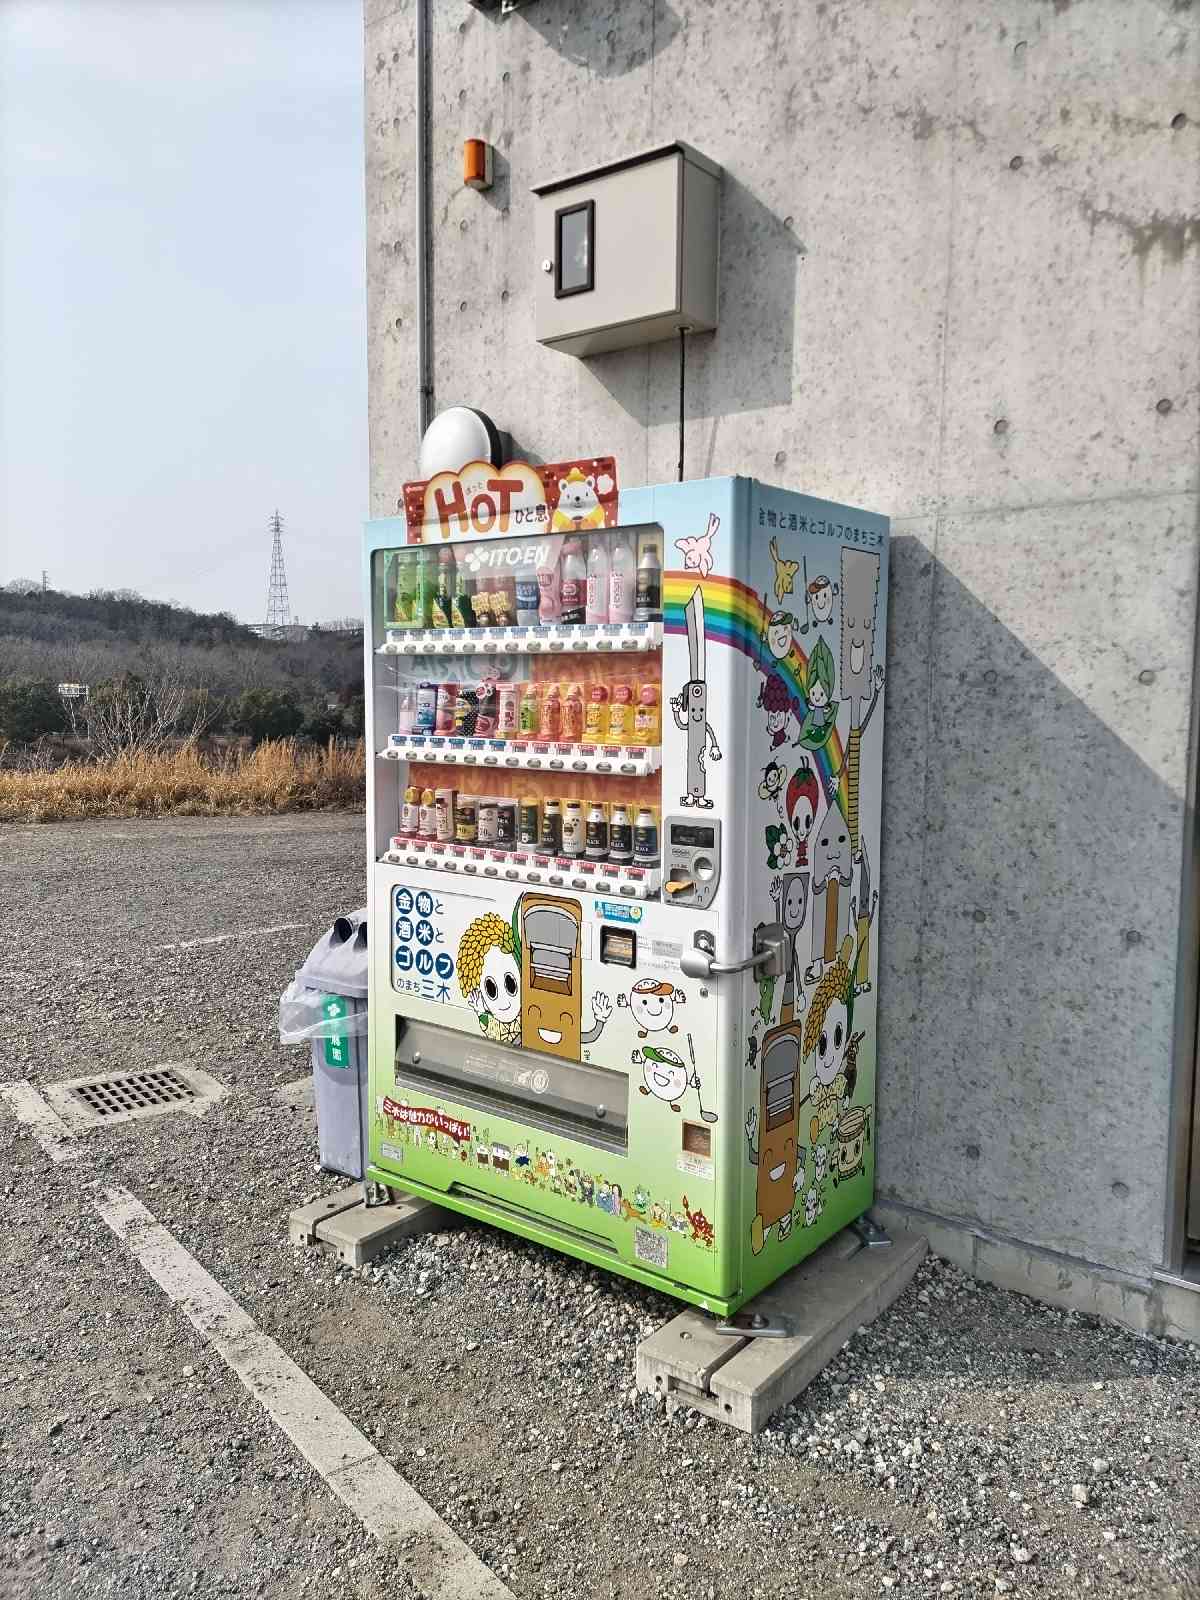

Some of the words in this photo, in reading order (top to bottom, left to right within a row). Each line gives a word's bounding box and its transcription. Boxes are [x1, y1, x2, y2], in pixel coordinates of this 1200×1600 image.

[514, 504, 547, 524] ひと息
[397, 891, 444, 914] 金物と
[398, 920, 445, 943] 酒米と
[398, 949, 452, 975] ゴルフ
[396, 979, 451, 1004] のまち三木
